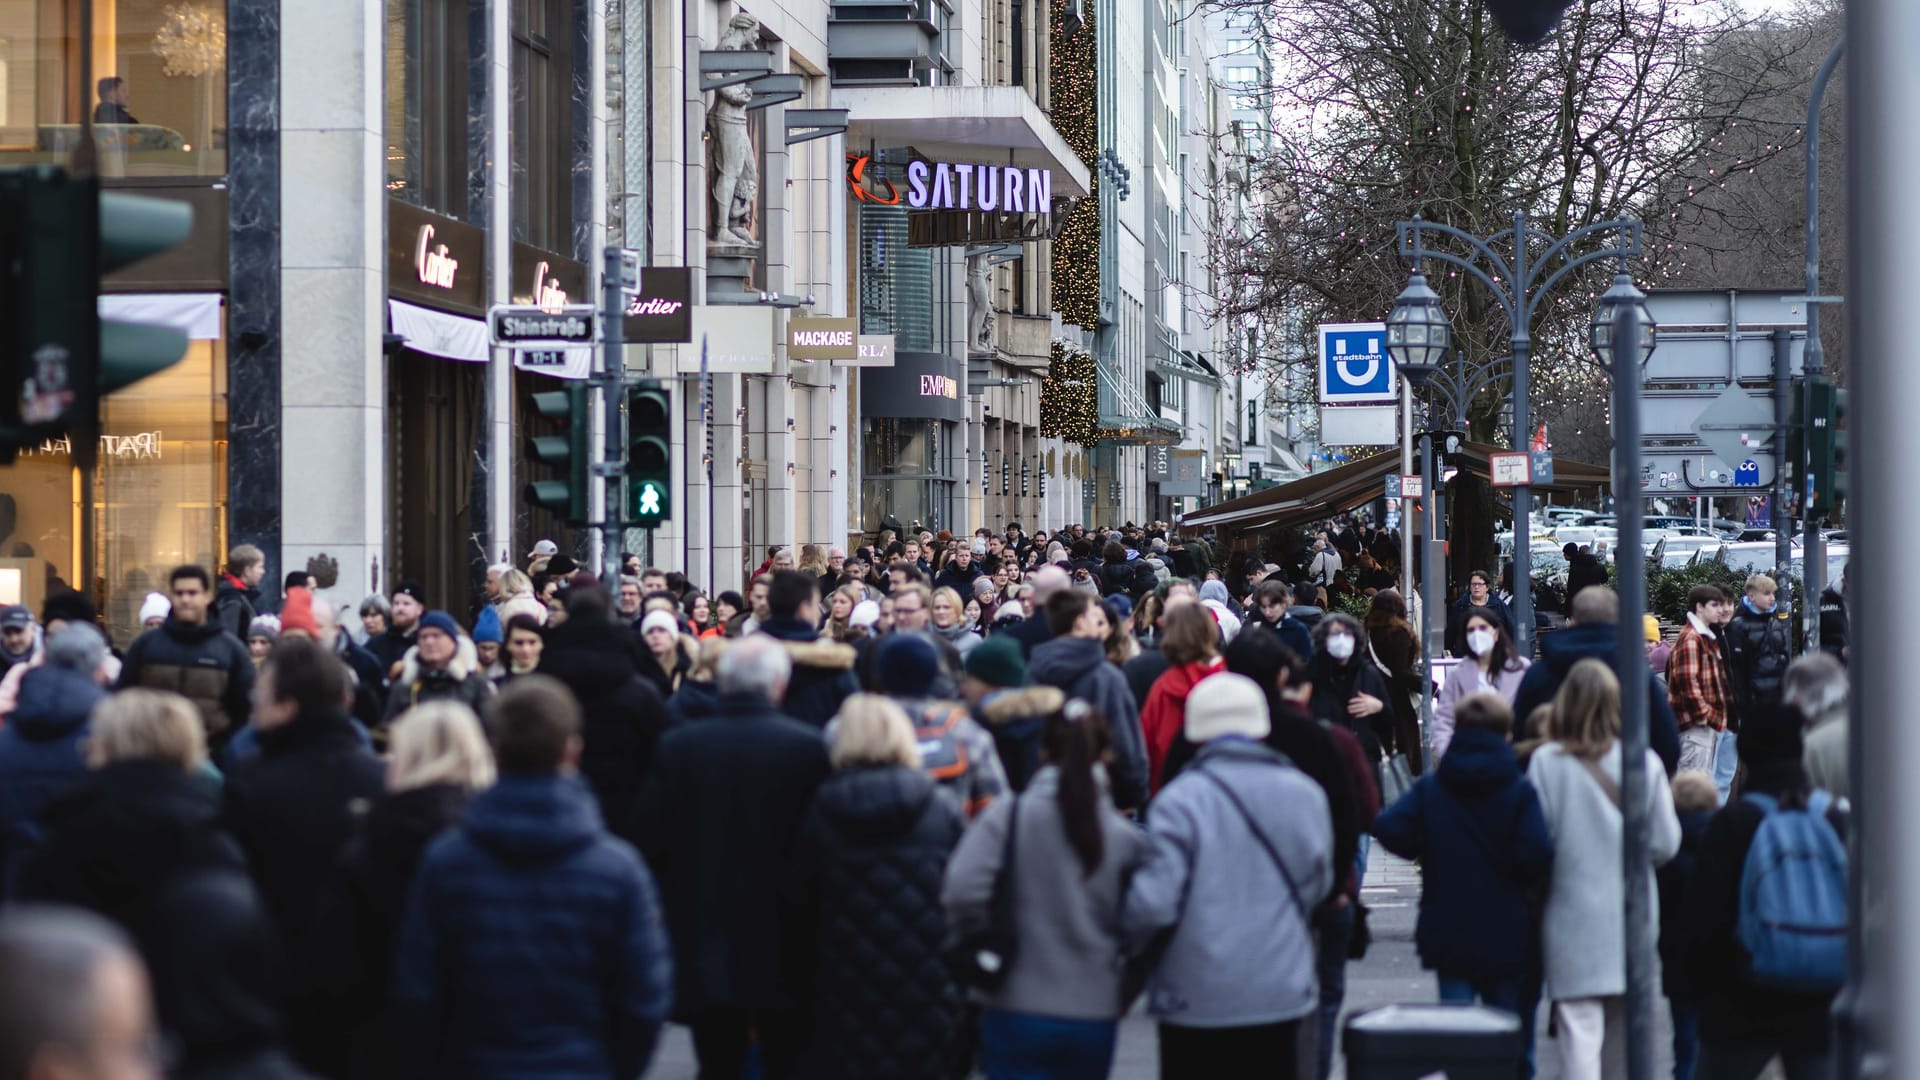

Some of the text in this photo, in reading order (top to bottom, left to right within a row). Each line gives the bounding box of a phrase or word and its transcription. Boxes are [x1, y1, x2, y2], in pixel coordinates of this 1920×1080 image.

[908, 160, 1050, 213] SATURN
[417, 224, 458, 288] Cartier
[504, 317, 586, 337] Steinstraße
[794, 331, 852, 346] MACKAGE
[859, 344, 889, 357] RLA
[1332, 353, 1382, 361] stadtbahn
[1158, 446, 1167, 474] OGGI
